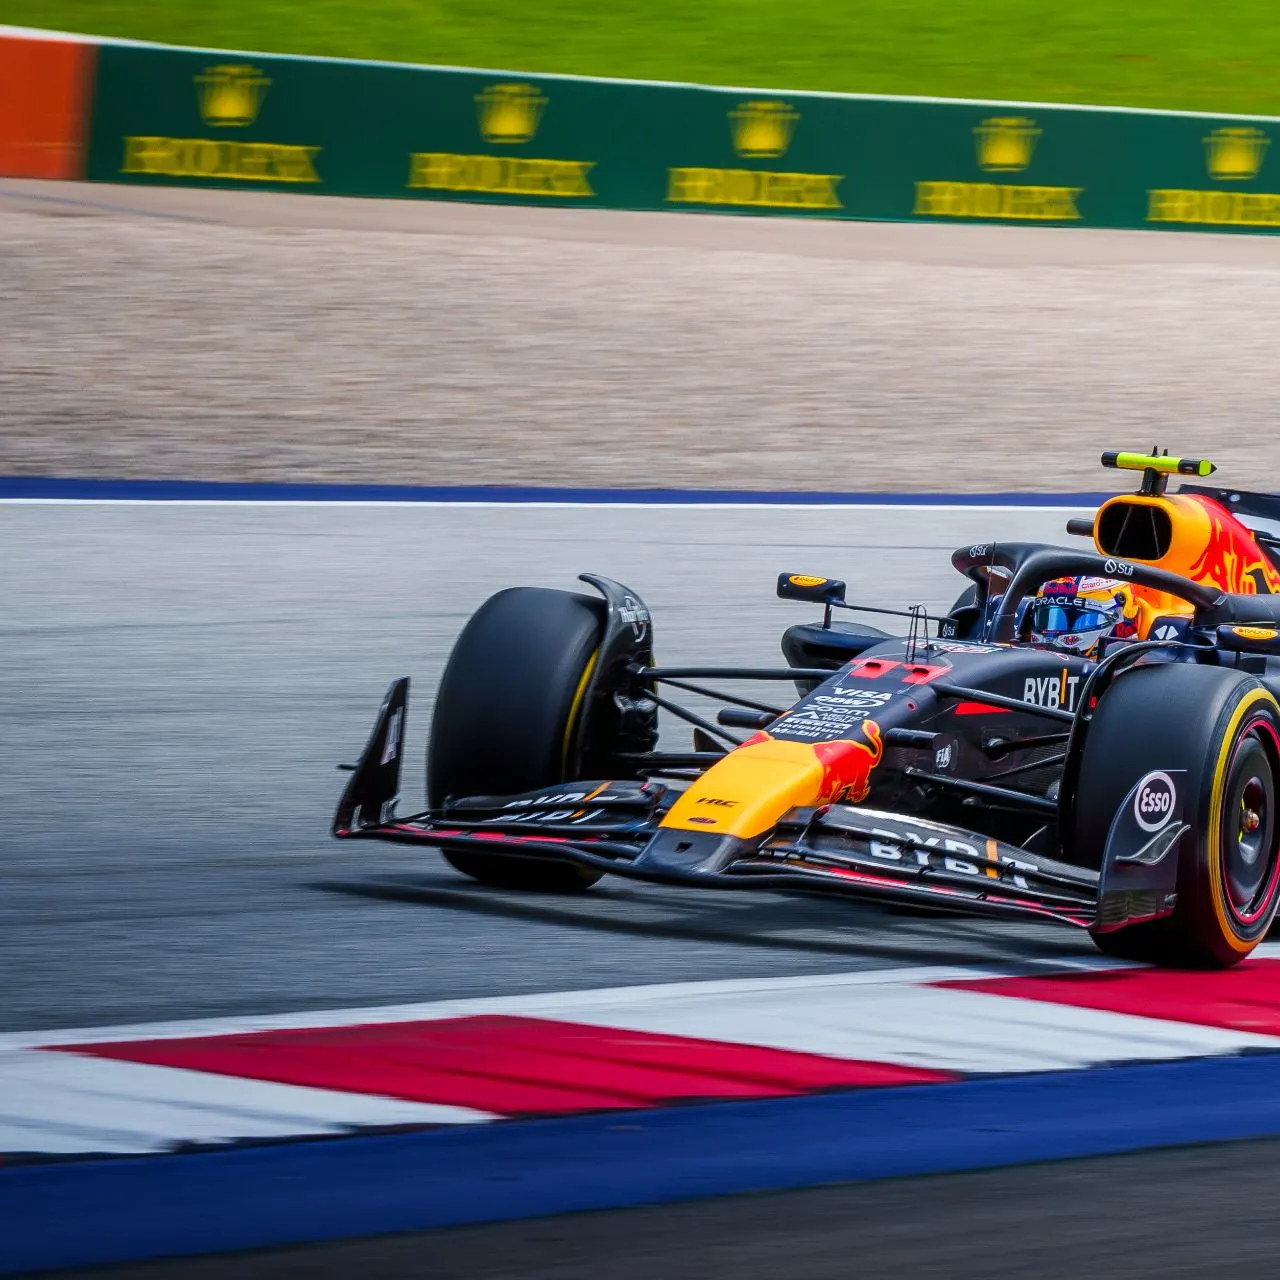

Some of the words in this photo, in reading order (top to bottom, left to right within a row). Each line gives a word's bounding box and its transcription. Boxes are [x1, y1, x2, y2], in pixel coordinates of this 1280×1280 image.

[1036, 596, 1083, 607] ORACLE
[832, 686, 893, 701] VISA
[1024, 668, 1080, 712] BYBIT
[1141, 787, 1170, 812] Esso
[869, 828, 1039, 890] BYBIT
